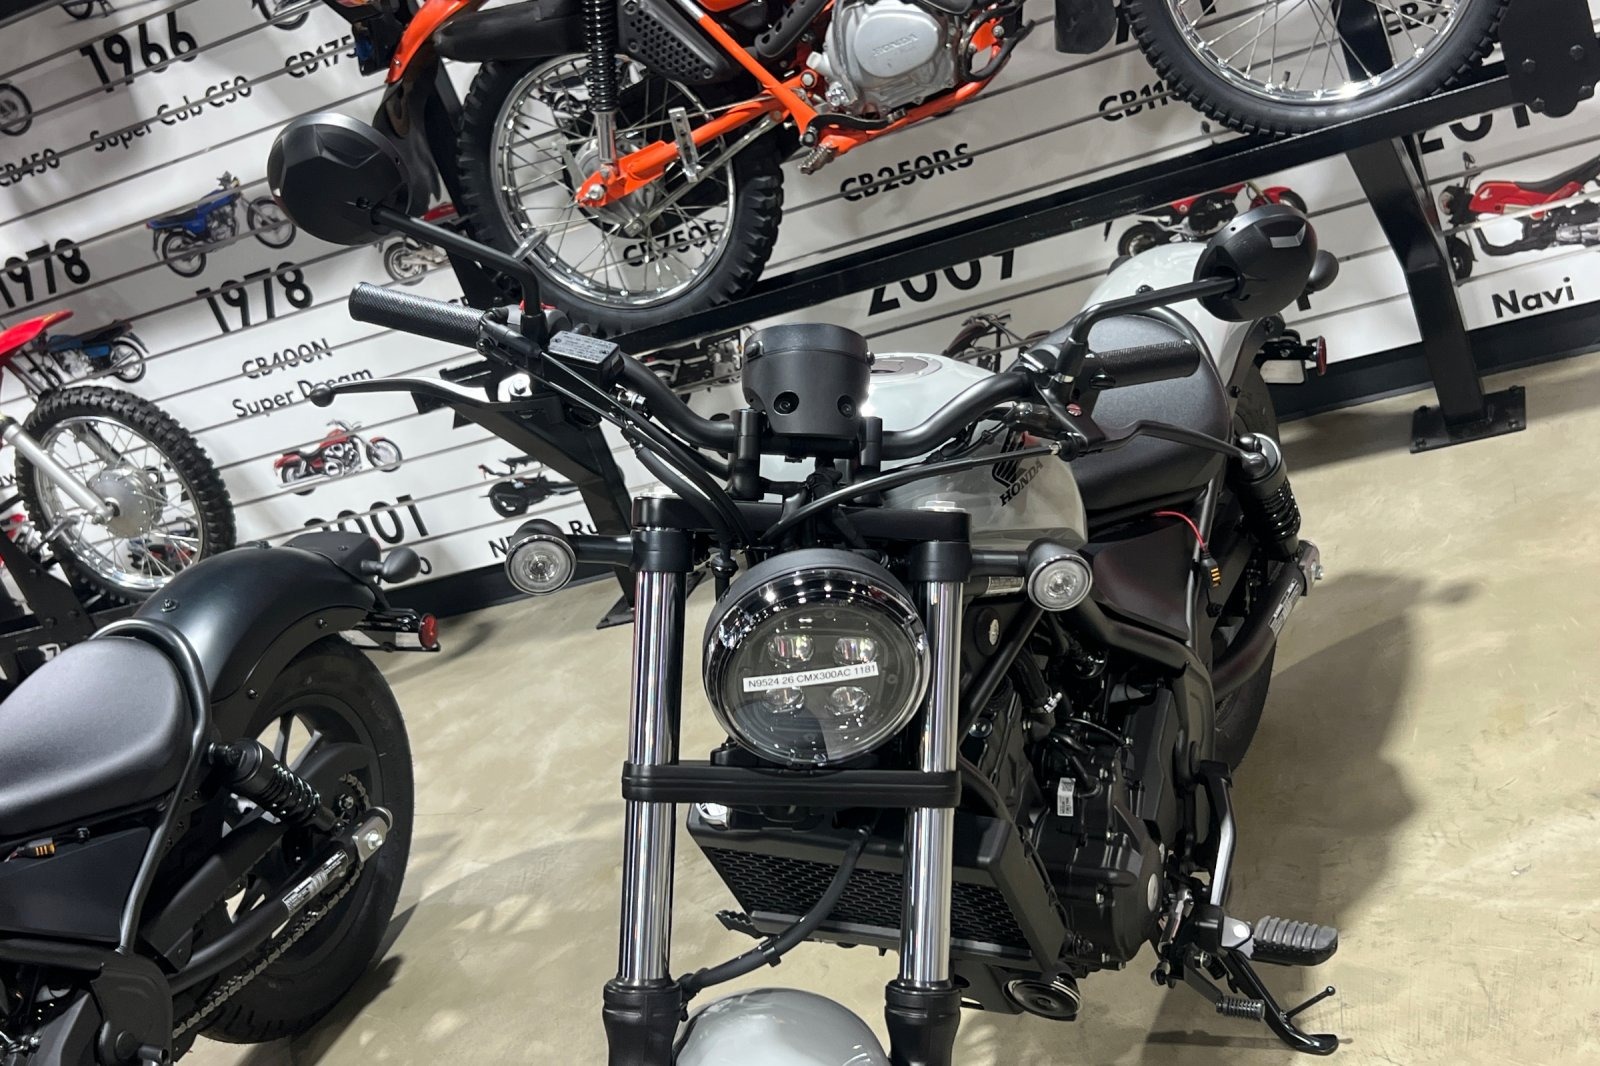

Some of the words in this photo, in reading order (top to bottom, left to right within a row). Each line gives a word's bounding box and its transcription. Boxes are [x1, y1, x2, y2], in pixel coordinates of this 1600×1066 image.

[80, 11, 198, 93] 1966
[284, 34, 359, 78] CD175
[157, 95, 203, 125] Cub
[205, 75, 252, 108] C50
[1099, 79, 1178, 122] CB11
[840, 142, 974, 203] CB250RS
[0, 238, 91, 309] 1978
[195, 261, 313, 334] 1978
[1492, 276, 1576, 319] Navi
[242, 337, 333, 379] CB400N
[232, 390, 294, 418] Super
[999, 458, 1044, 507] HONDA
[748, 677, 780, 689] N9524
[781, 675, 795, 685] 26
[796, 668, 851, 684] CMX300AC
[854, 664, 877, 676] 1181
